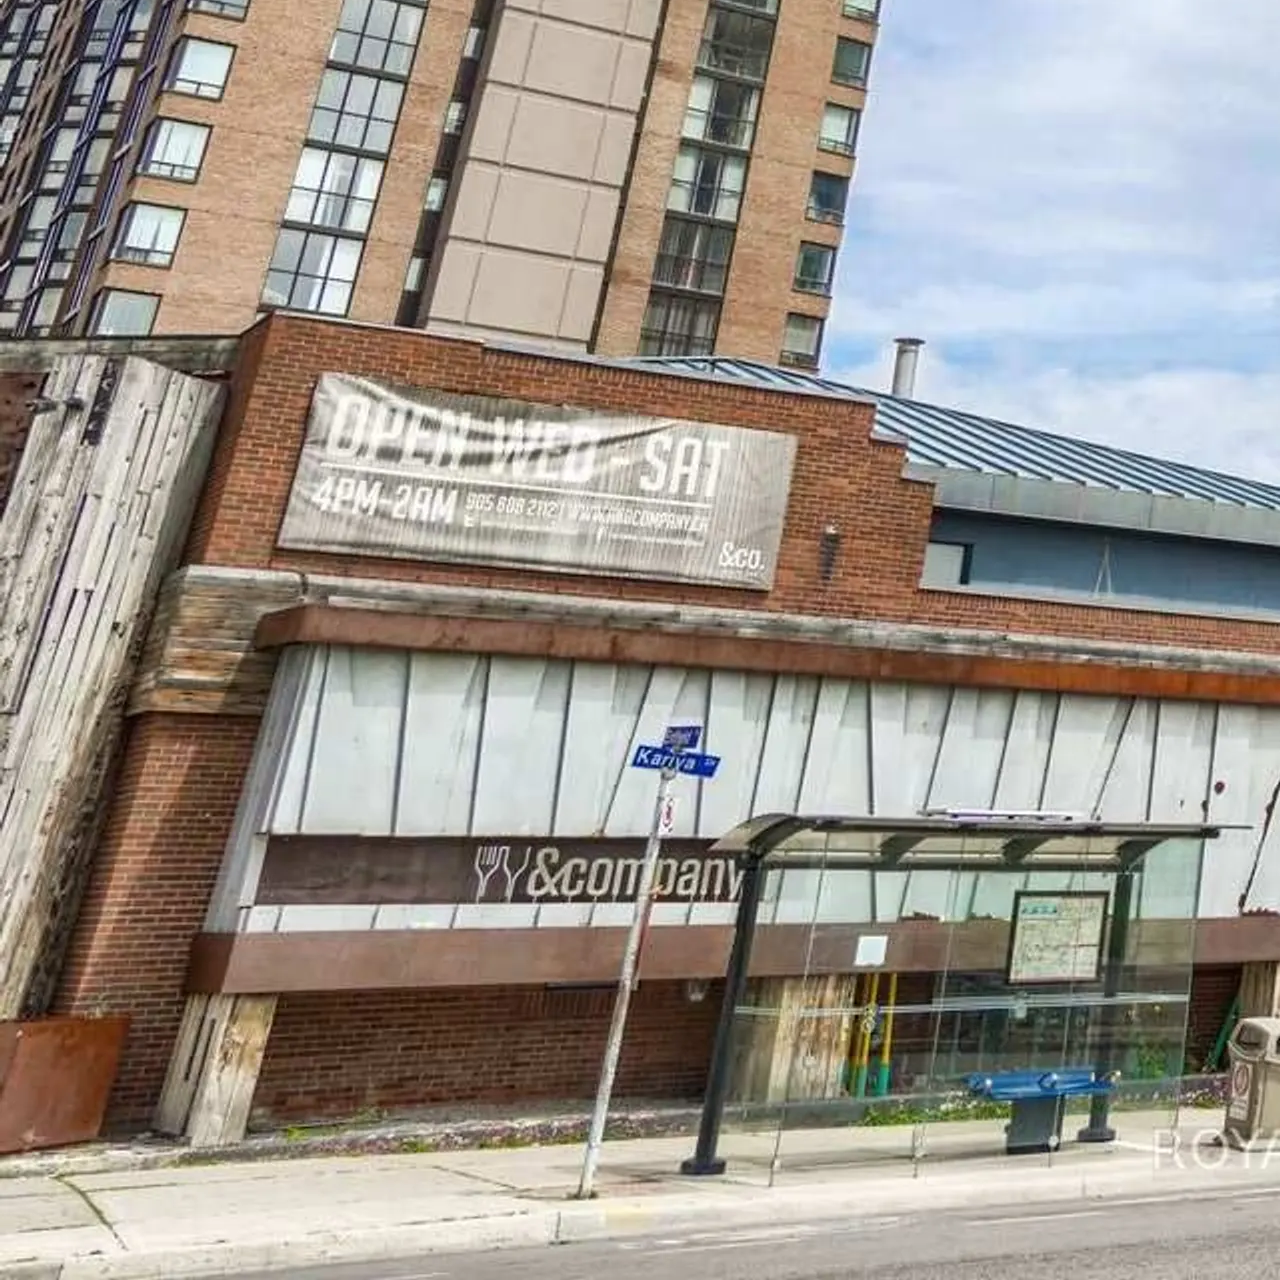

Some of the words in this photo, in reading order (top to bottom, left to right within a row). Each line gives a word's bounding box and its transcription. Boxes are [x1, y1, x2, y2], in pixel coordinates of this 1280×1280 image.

[326, 393, 472, 468] OPEN
[492, 416, 599, 483] WED
[640, 435, 731, 498] SAT
[311, 475, 458, 524] 4PM-2AM
[637, 747, 697, 772] Kariya
[527, 847, 745, 903] &company
